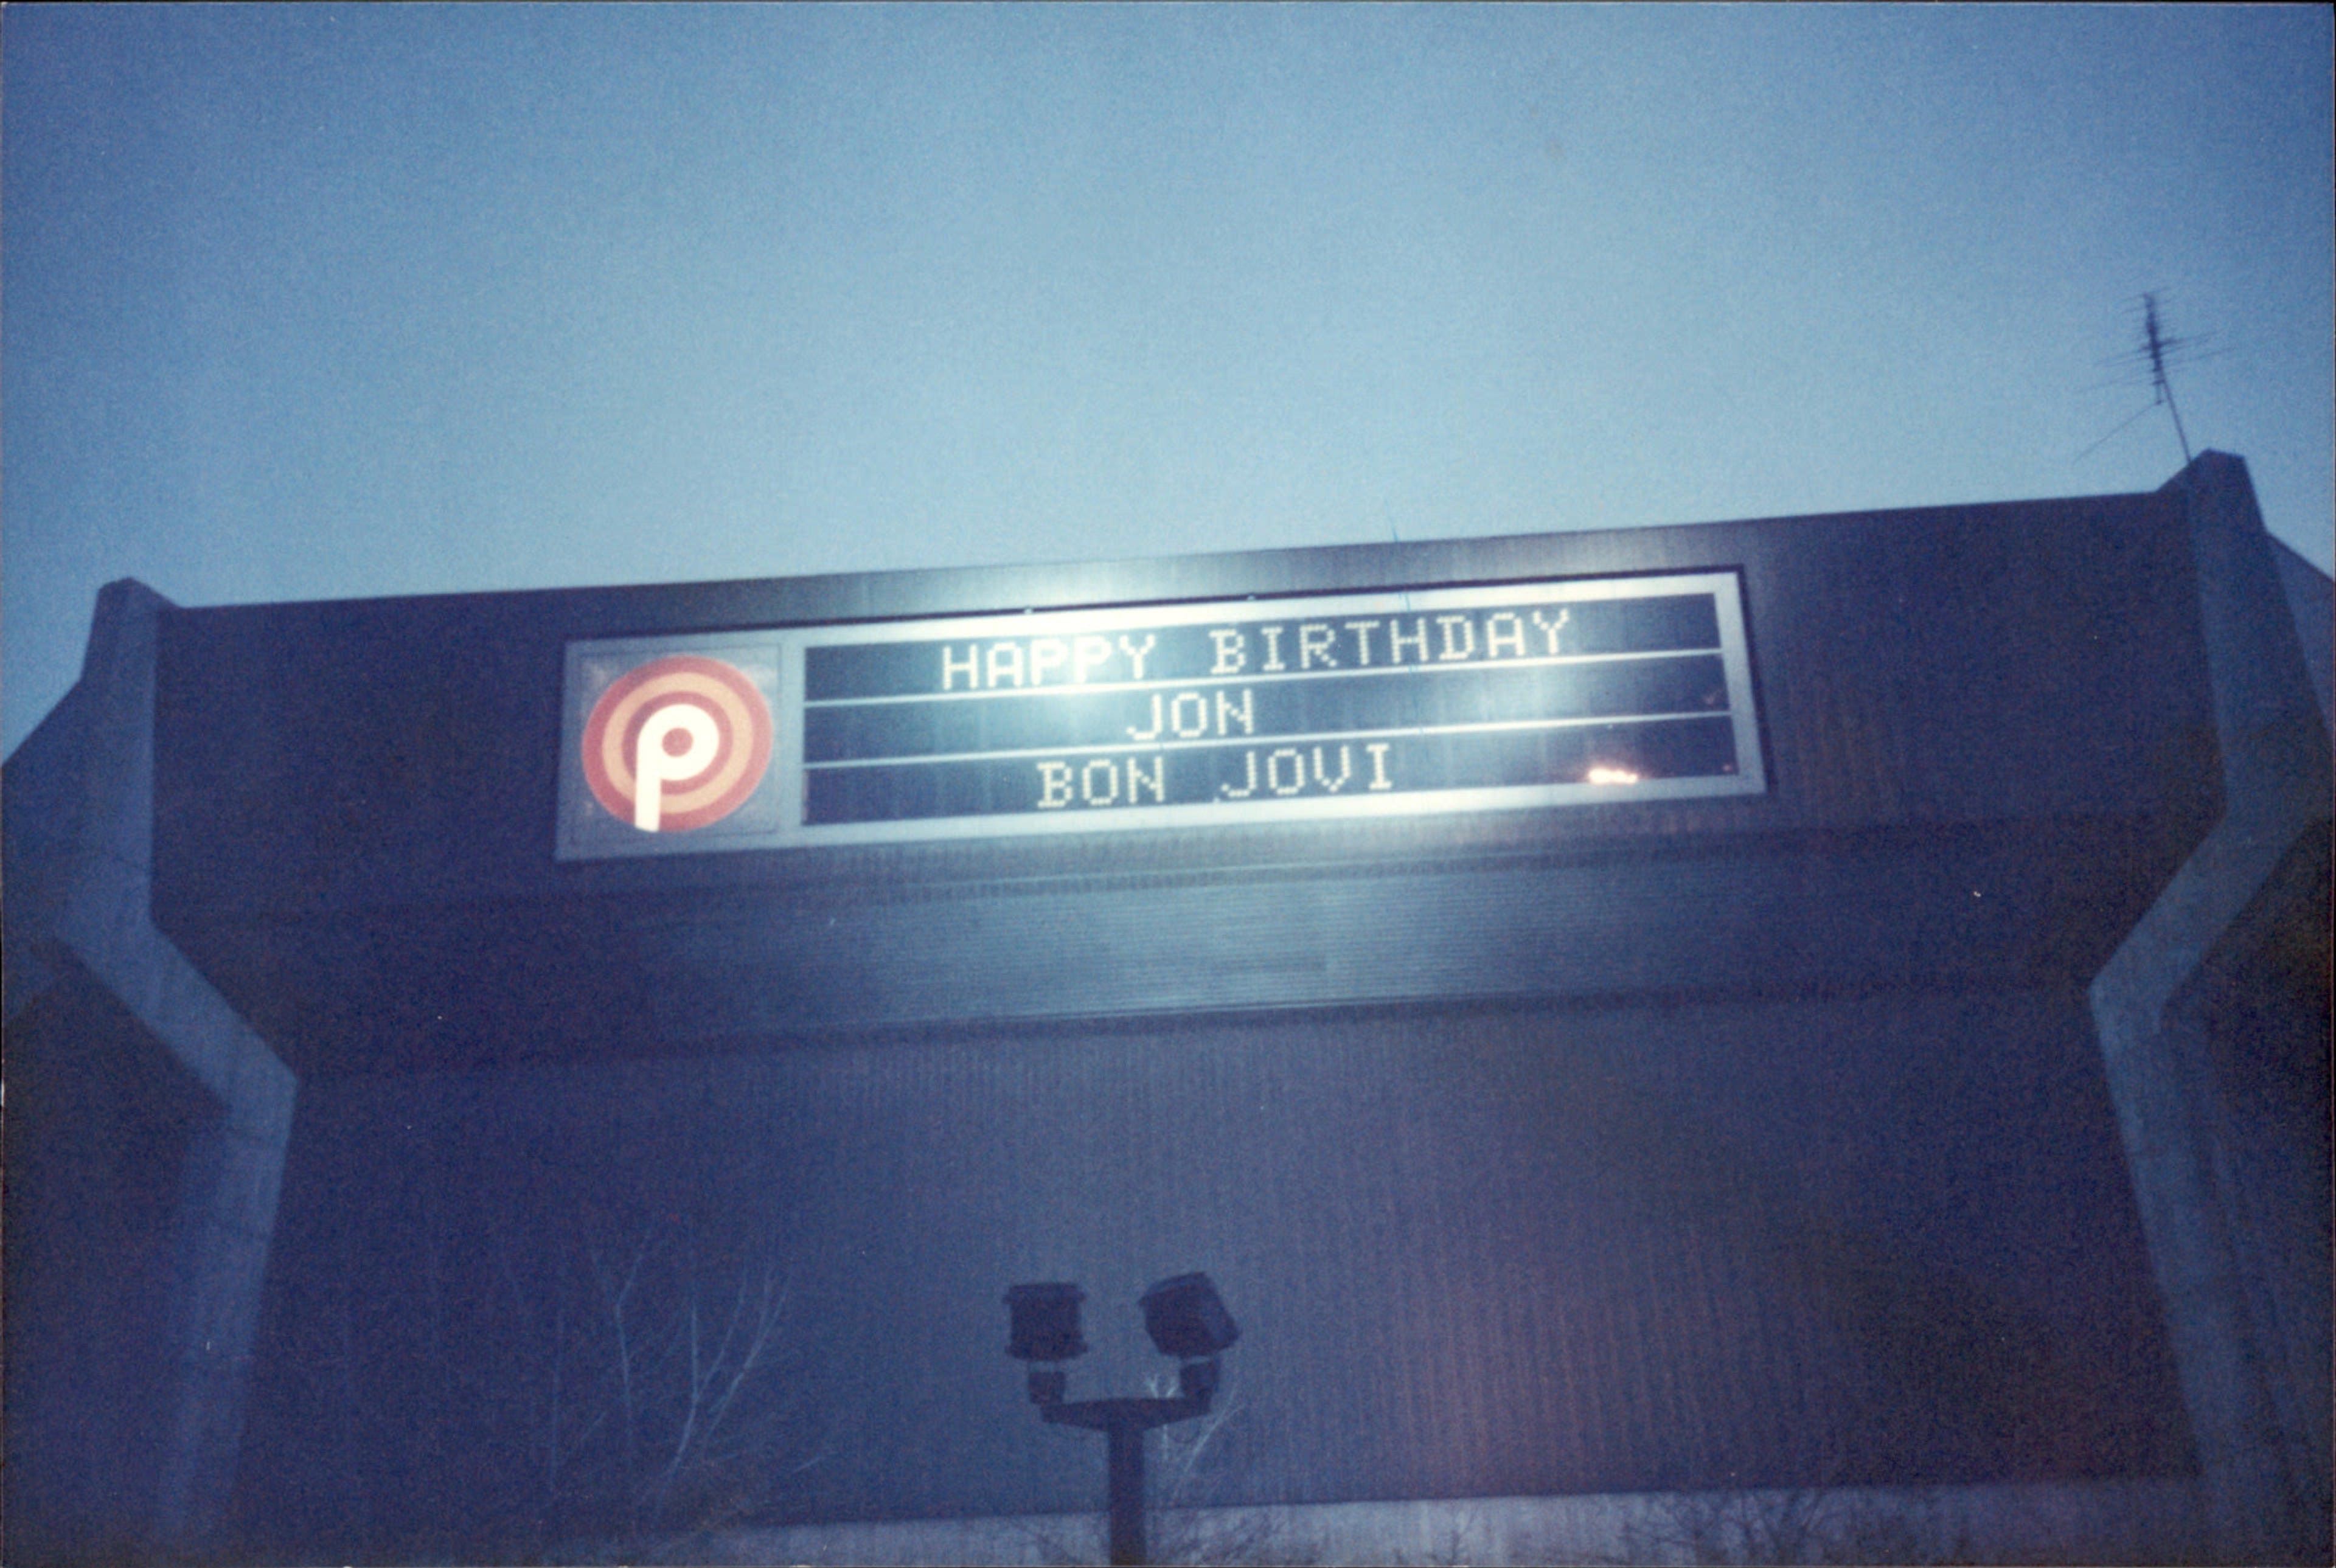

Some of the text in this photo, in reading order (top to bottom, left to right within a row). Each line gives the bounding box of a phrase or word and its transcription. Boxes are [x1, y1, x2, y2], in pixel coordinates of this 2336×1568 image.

[942, 608, 1571, 691] HAPPY BIRTHDAY
[1127, 688, 1253, 740] JON
[1037, 743, 1393, 809] BON JOVI
